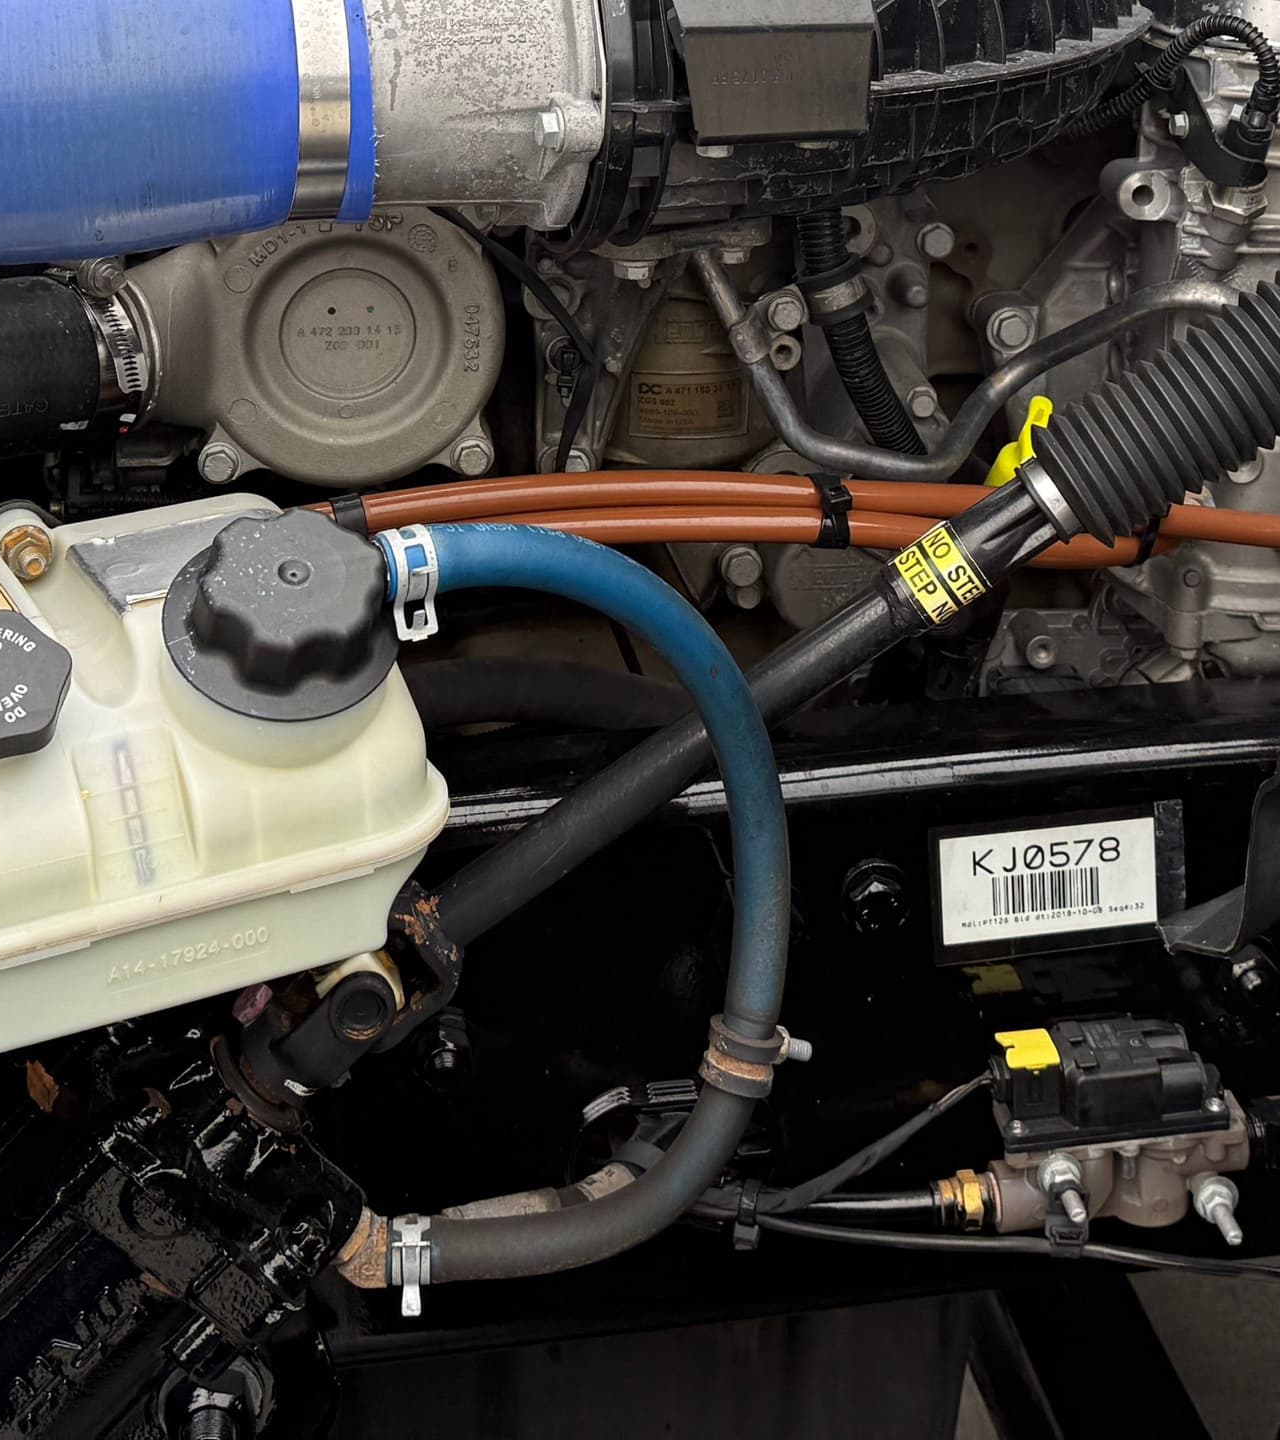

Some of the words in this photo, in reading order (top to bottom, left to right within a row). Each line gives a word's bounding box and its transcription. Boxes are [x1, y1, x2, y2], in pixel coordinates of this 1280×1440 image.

[353, 212, 403, 231] TOP
[638, 383, 662, 394] DC
[925, 530, 951, 559] NO
[898, 549, 938, 596] STEP
[4, 708, 27, 724] DO
[972, 837, 1121, 876] KJ0578
[107, 927, 269, 984] A14-17924-000
